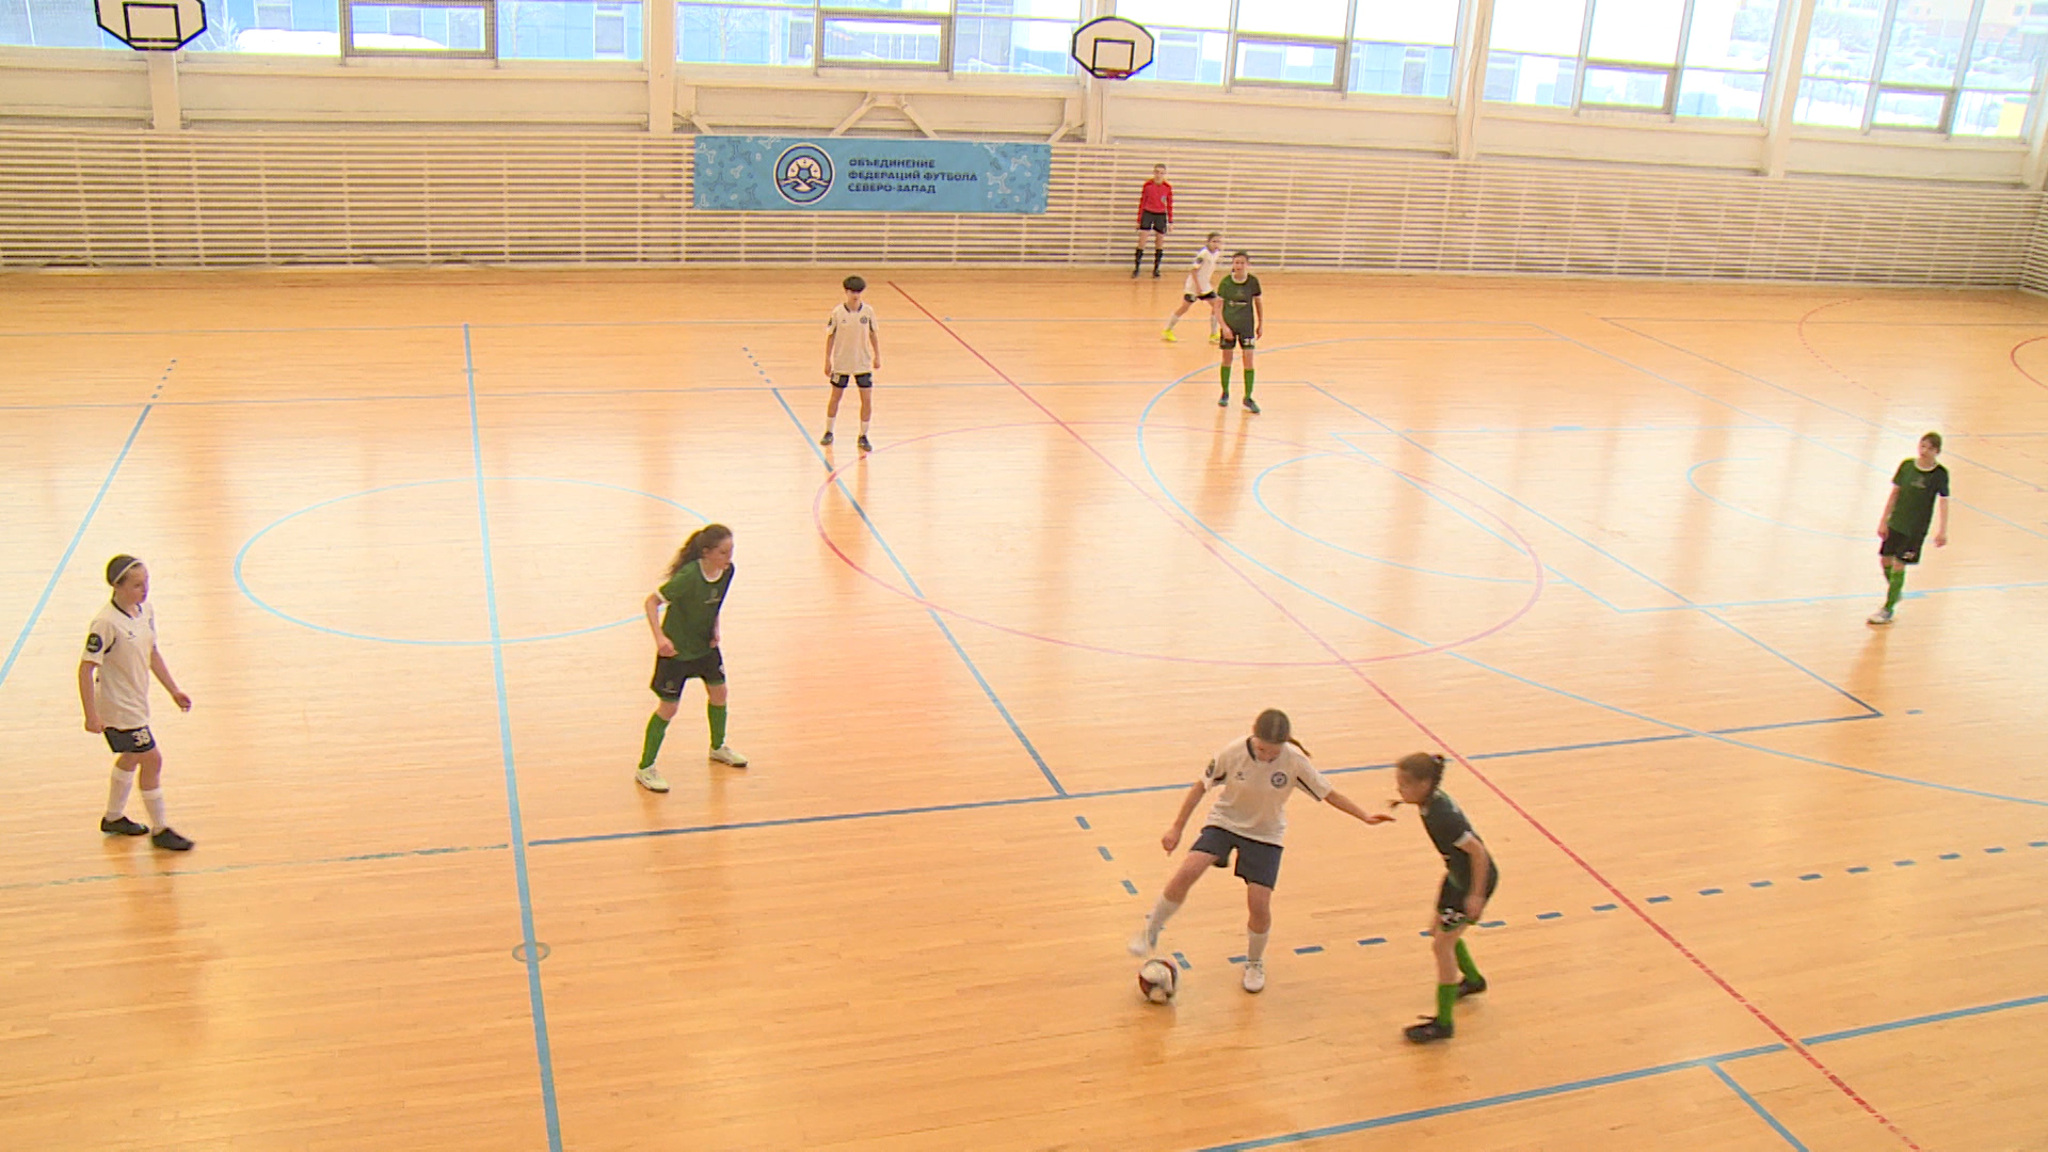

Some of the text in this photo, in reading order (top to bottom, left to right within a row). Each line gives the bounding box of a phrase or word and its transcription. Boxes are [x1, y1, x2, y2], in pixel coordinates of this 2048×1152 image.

[849, 158, 936, 169] ОБЪЕДИНЕНИЕ
[848, 170, 978, 183] ФЕДЕРАЦИЙ ФУТБОЛА
[848, 183, 936, 194] СЕВЕРО-ЗАПАД
